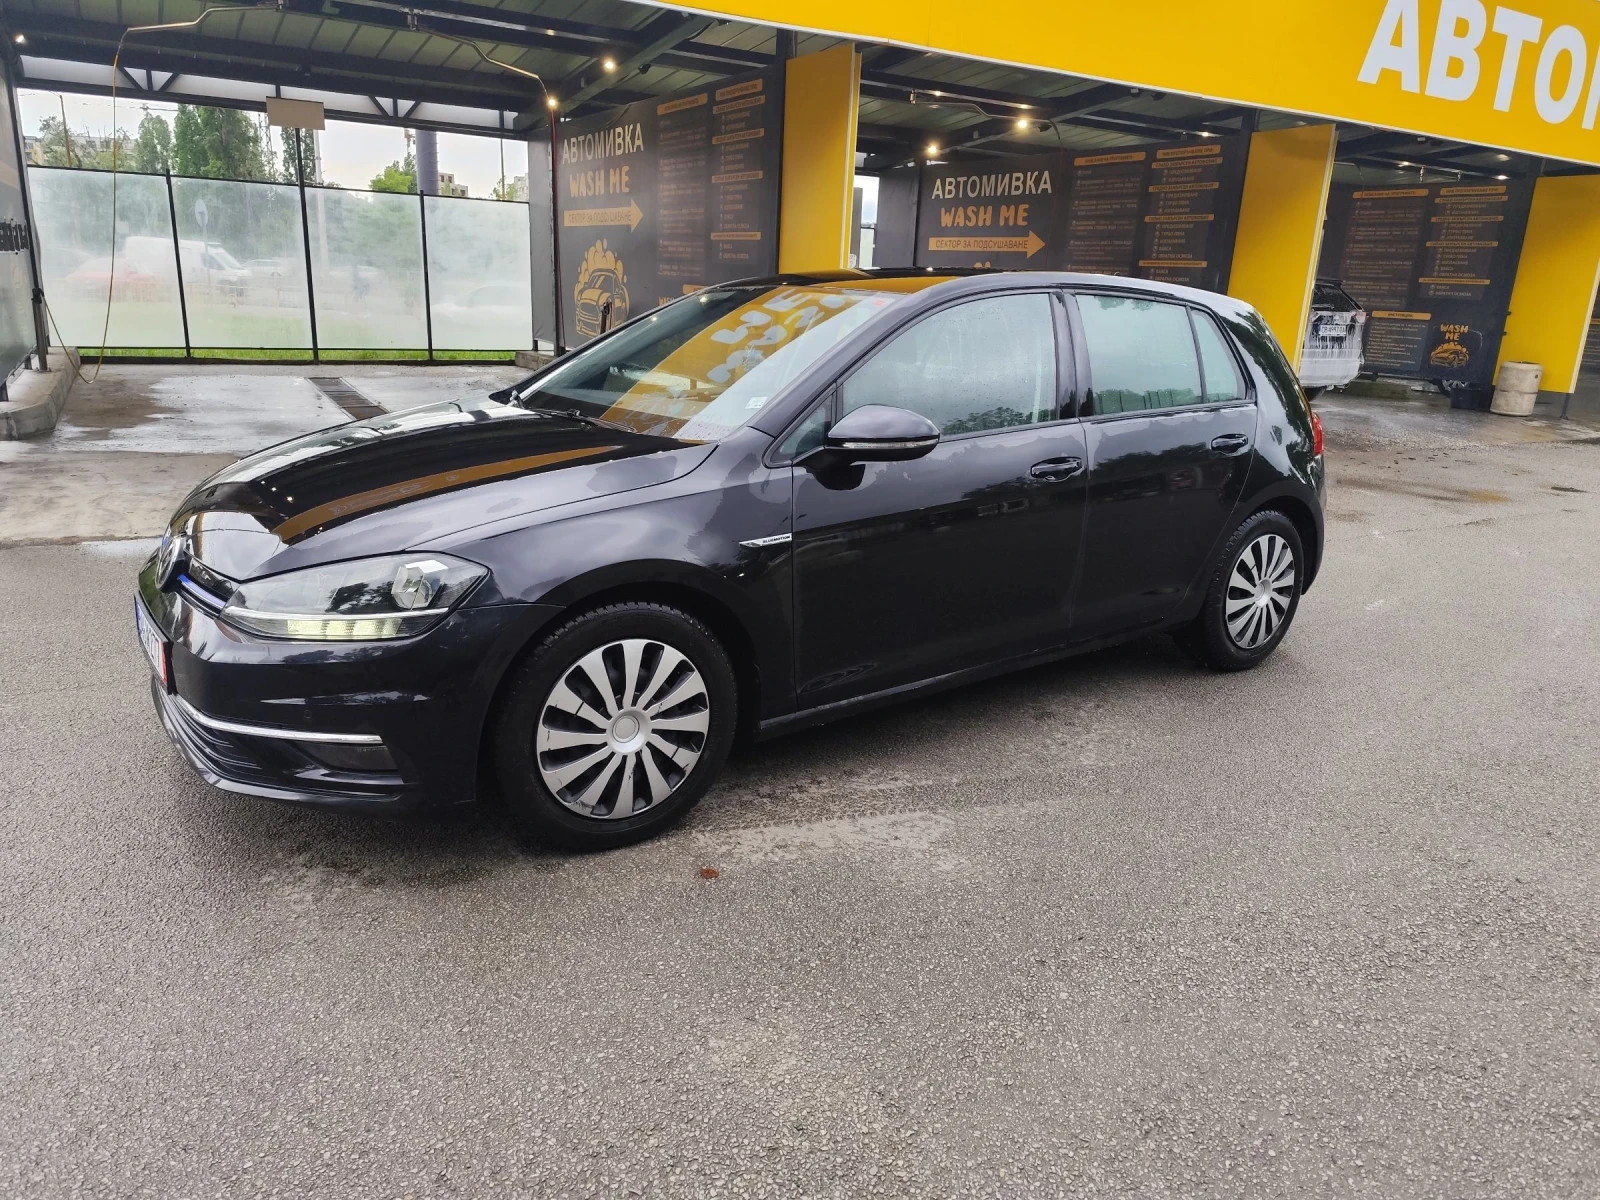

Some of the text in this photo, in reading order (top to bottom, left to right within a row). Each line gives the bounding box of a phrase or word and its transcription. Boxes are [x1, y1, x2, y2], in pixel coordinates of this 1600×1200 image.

[562, 123, 644, 164] АВТОМИВКА
[570, 165, 630, 198] WASH ME
[932, 170, 1052, 200] АВТОМИВКА
[940, 203, 1030, 227] WASH ME
[936, 240, 1028, 250] СЕКТОР ЗА ПОДСУШАВАНЕ
[1440, 324, 1469, 334] WASH
[1445, 332, 1460, 340] ME
